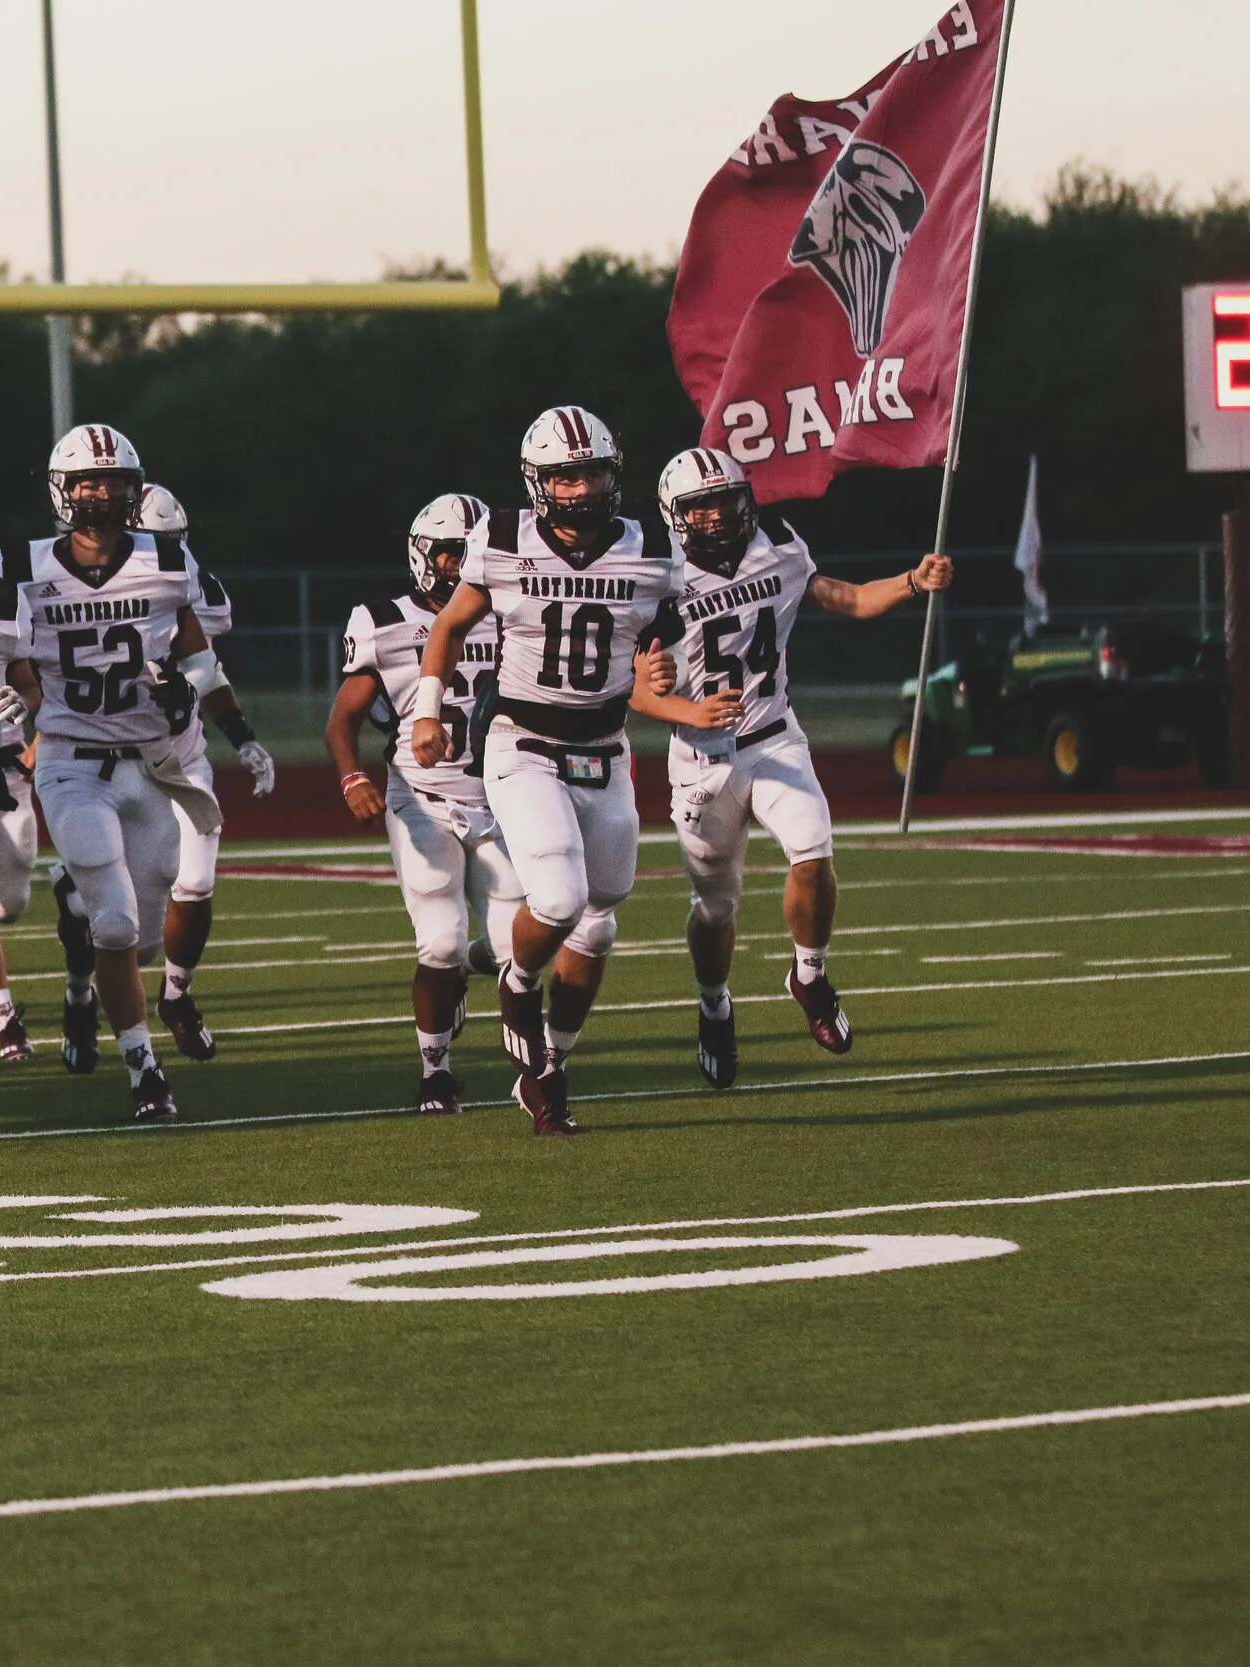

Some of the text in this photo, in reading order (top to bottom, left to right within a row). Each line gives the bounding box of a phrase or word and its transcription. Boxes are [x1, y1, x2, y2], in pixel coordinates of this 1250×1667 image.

[44, 598, 150, 625] EAST BERNARD
[519, 576, 636, 600] EAST BERNARD
[686, 575, 782, 621] EAST BERNARD
[57, 623, 144, 716] 52
[537, 601, 615, 692] 10
[701, 605, 780, 698] 54
